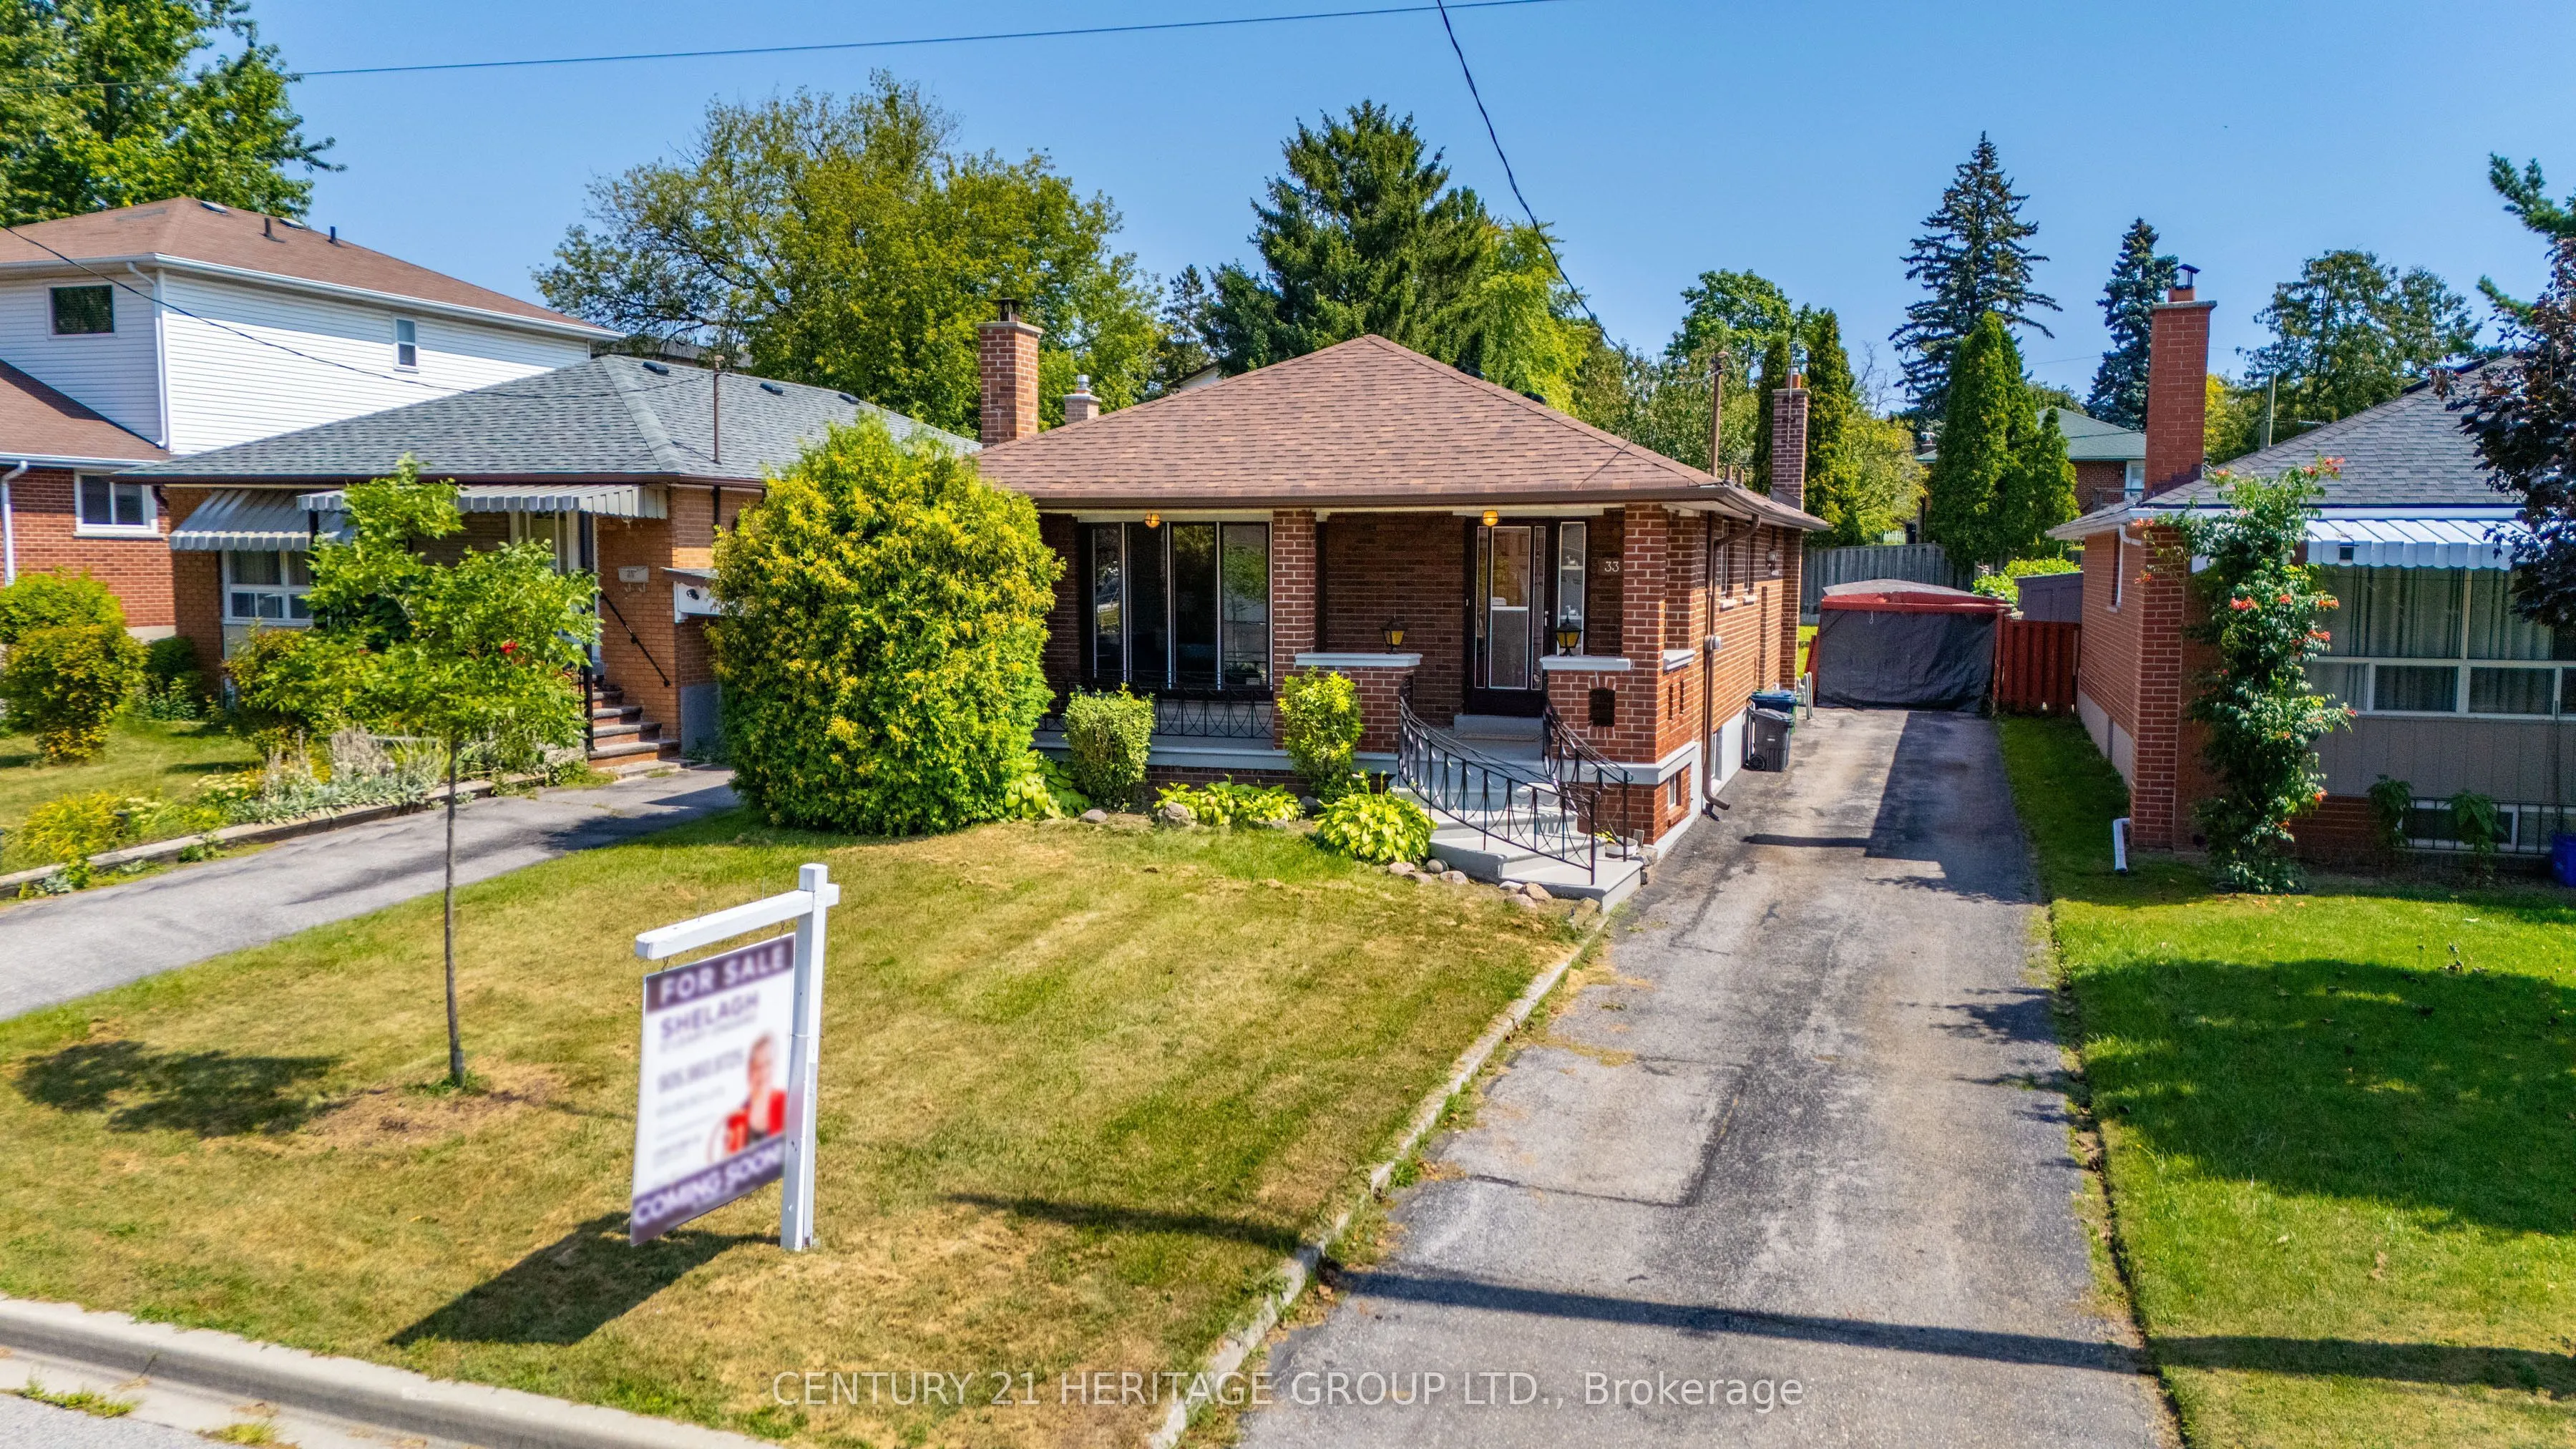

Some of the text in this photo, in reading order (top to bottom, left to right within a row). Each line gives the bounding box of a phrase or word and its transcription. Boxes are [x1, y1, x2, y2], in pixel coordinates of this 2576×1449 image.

[1604, 561, 1619, 572] 33
[660, 943, 785, 1005] FOR SALE
